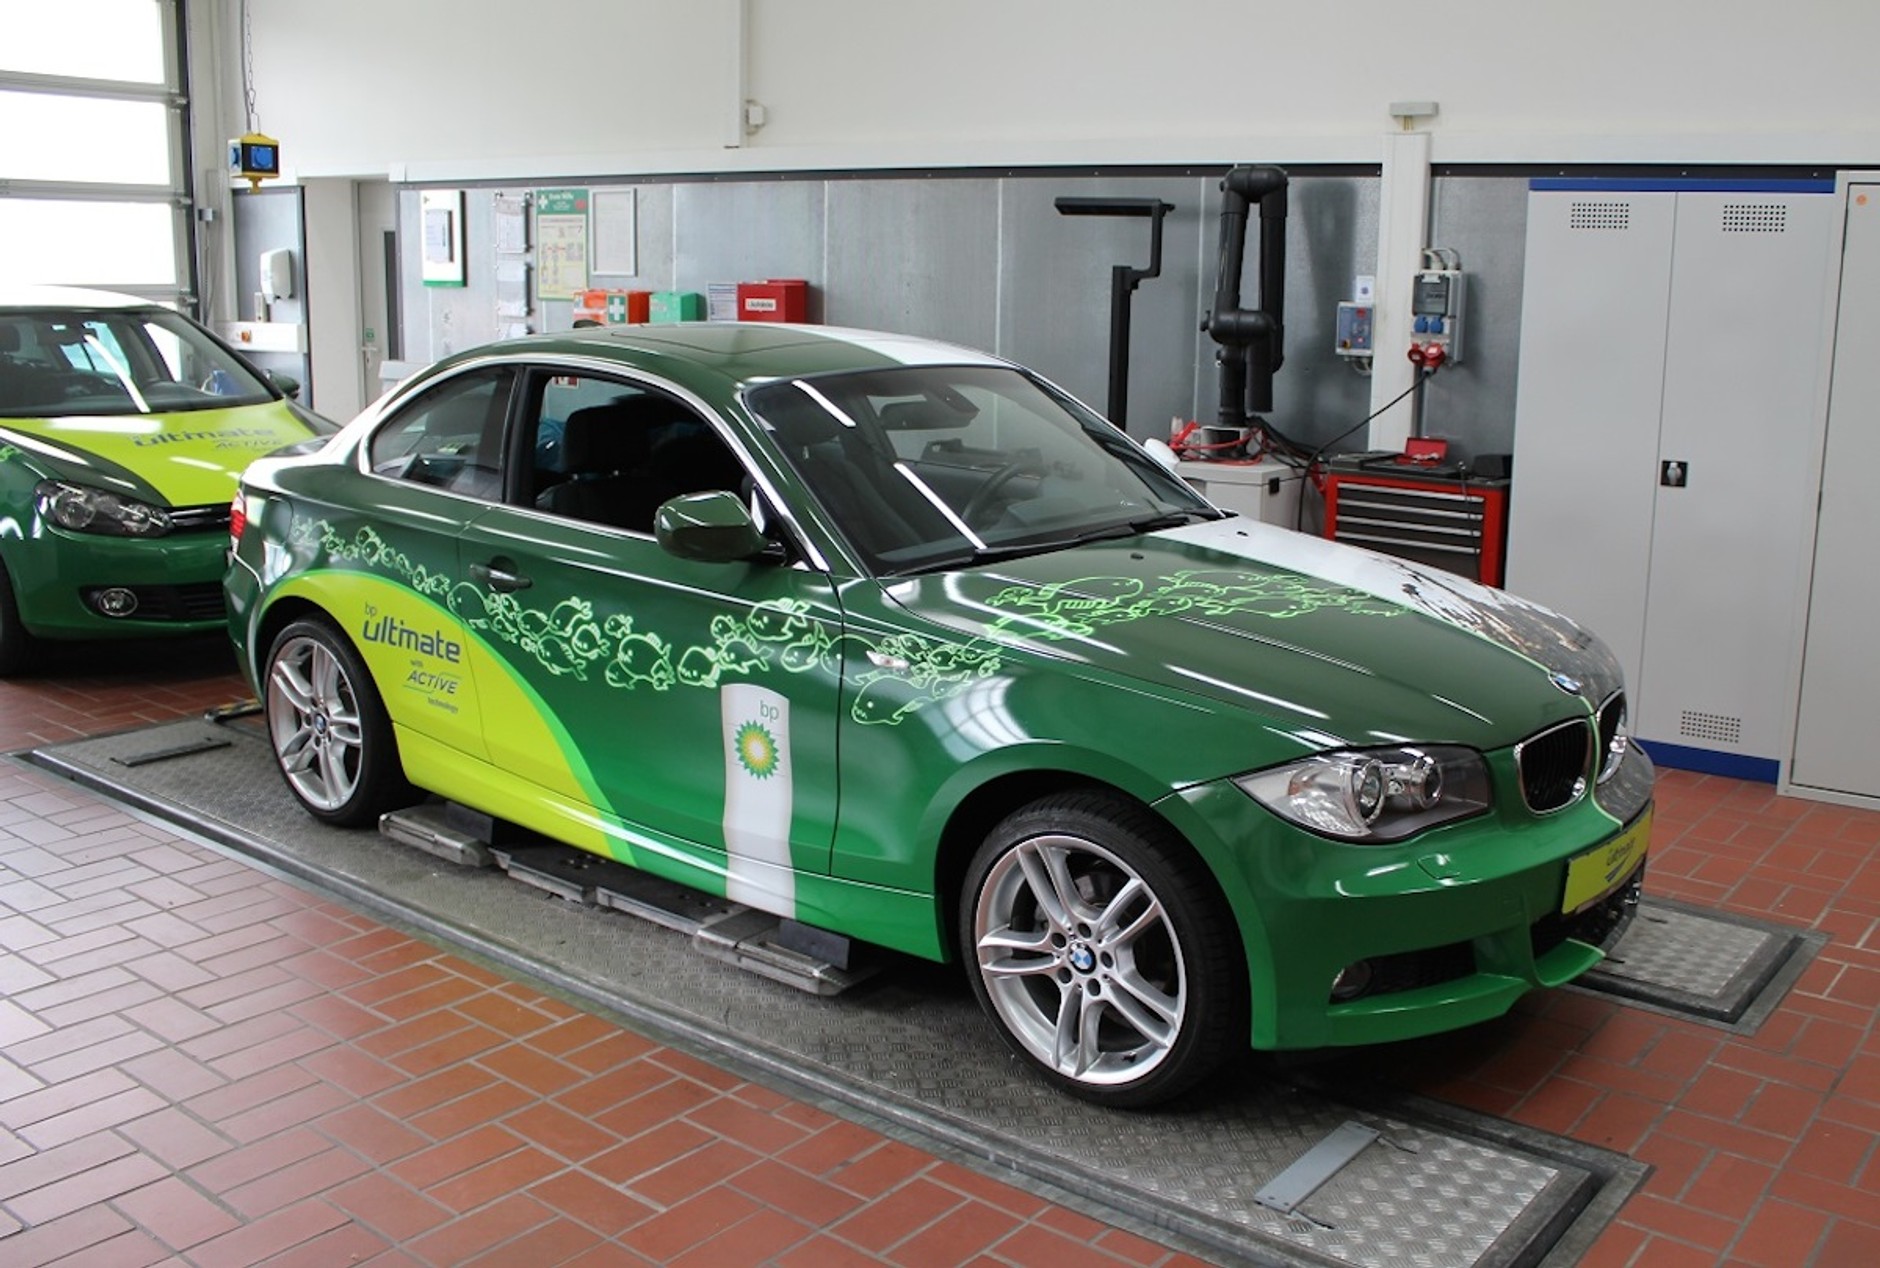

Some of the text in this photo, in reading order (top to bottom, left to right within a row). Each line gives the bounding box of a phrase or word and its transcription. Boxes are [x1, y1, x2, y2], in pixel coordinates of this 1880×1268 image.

[364, 602, 378, 618] bp
[363, 615, 461, 664] ultimate
[407, 670, 458, 695] ACTIVE
[760, 700, 780, 723] bp
